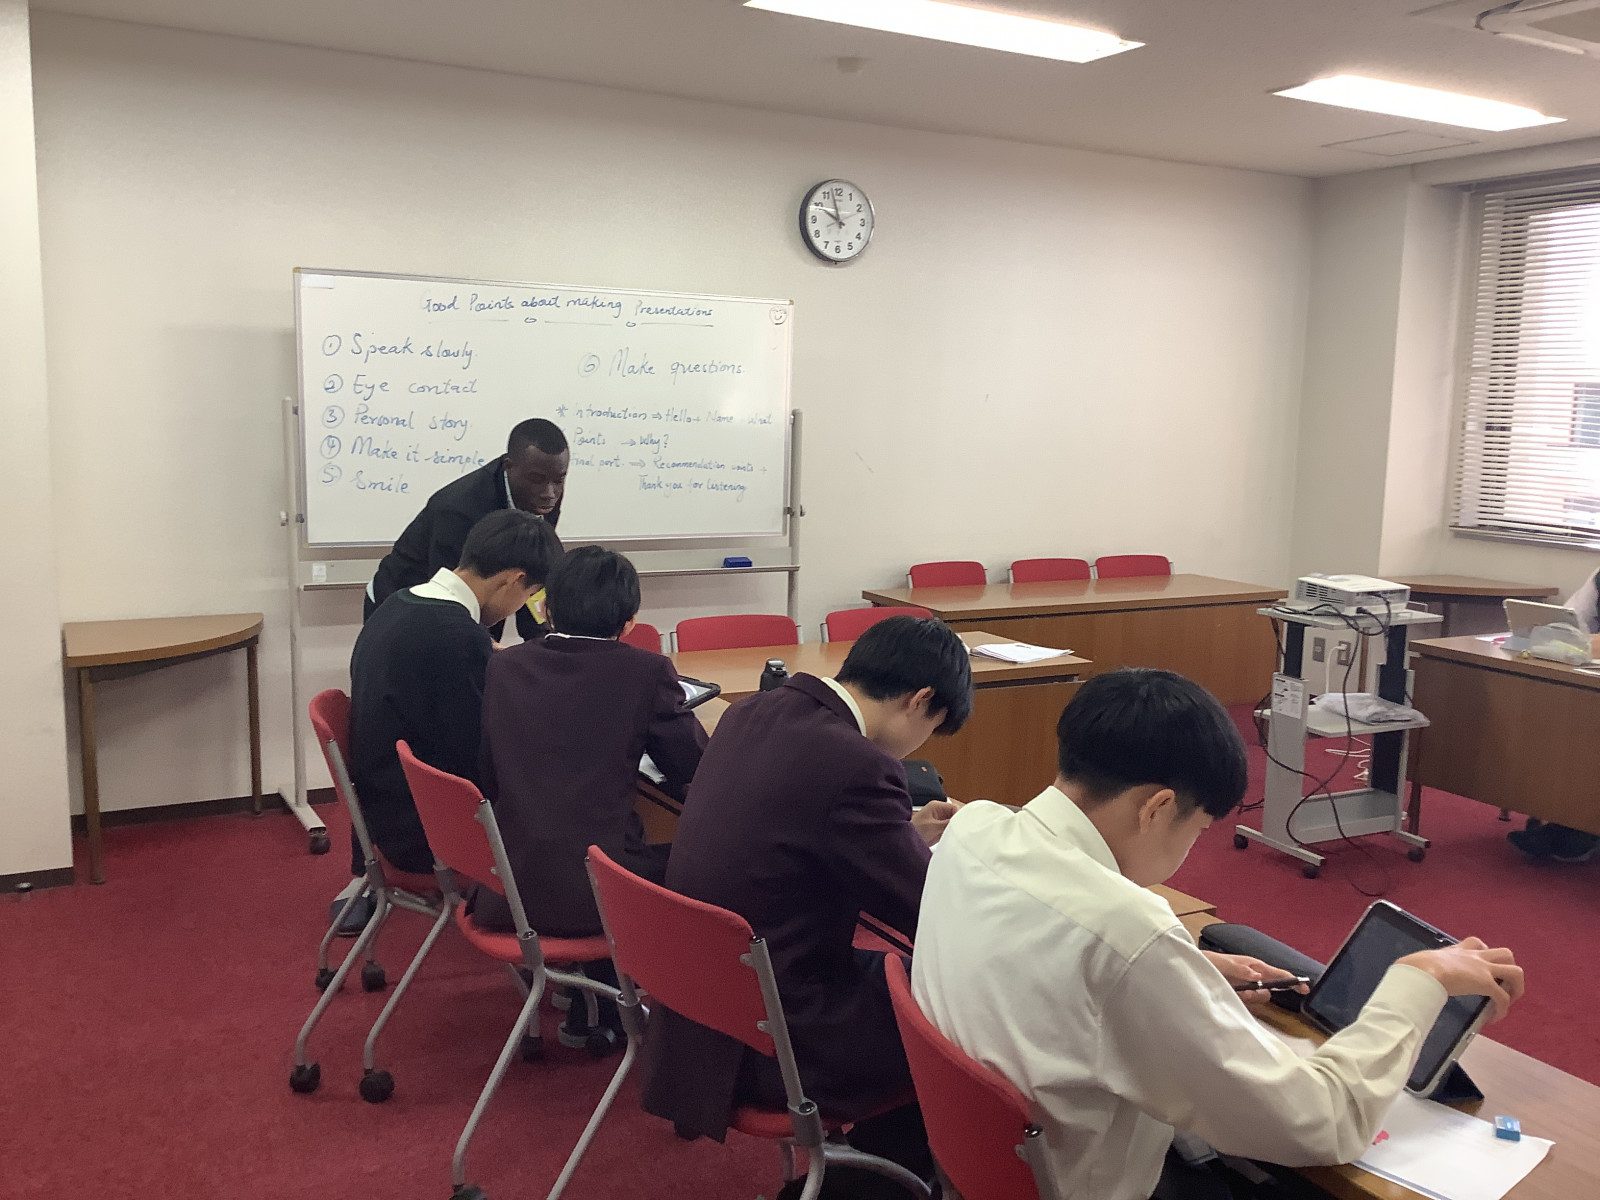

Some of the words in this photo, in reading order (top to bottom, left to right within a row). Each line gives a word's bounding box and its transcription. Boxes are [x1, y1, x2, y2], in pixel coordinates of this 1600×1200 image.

[822, 191, 830, 200] 11
[834, 188, 843, 197] 12
[848, 193, 853, 201] 1
[856, 204, 862, 213] 2
[811, 215, 817, 224] 9
[860, 219, 865, 227] 3
[814, 230, 820, 238] 8
[855, 232, 862, 240] 4
[824, 241, 829, 249] 7
[835, 245, 841, 253] 6
[847, 242, 853, 250] 5
[470, 293, 514, 312] Points
[521, 296, 560, 309] about
[567, 296, 622, 318] making
[635, 300, 713, 316] Presentations
[350, 332, 414, 363] Speak
[609, 347, 656, 377] Make
[353, 374, 389, 401] Eye
[408, 379, 478, 395] contact
[353, 403, 414, 430] Personal
[575, 404, 647, 420] ntroduction
[351, 436, 398, 460] Make
[406, 443, 419, 463] it
[351, 470, 410, 494] Smile
